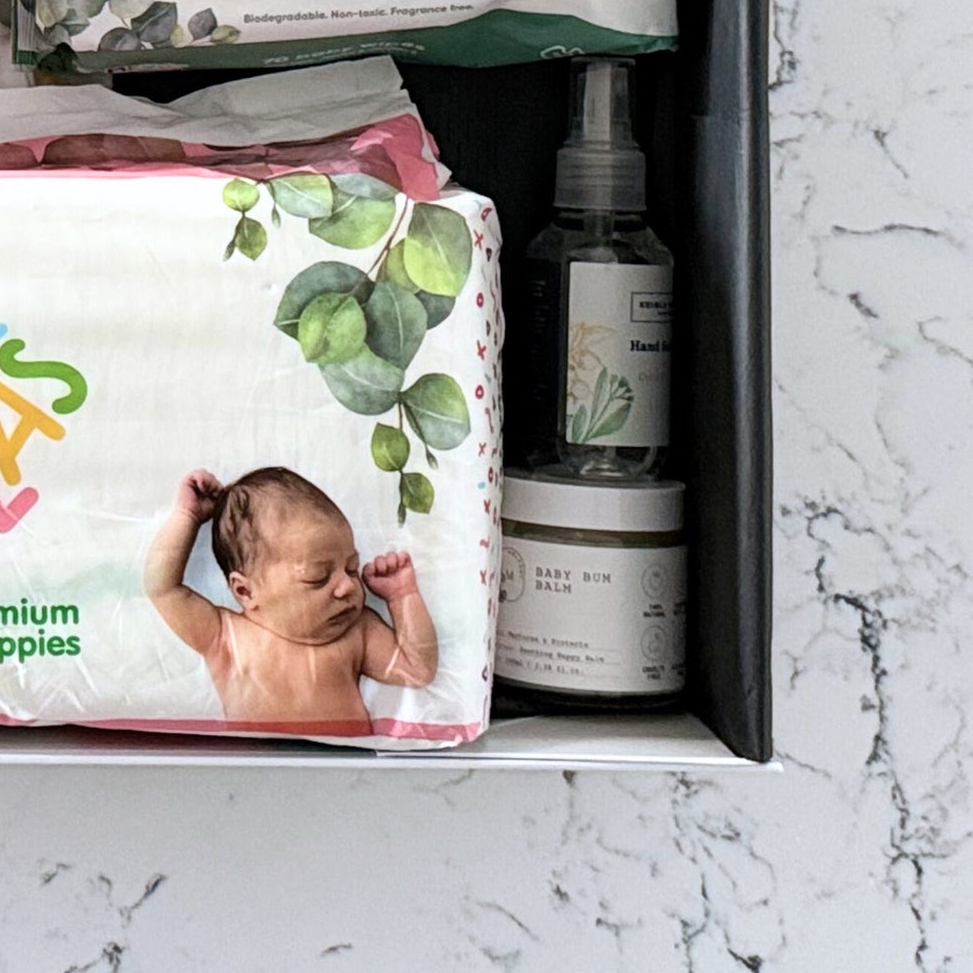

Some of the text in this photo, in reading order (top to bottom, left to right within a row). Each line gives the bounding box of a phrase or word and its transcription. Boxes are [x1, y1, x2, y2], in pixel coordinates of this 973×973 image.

[243, 10, 328, 24] Biodegradable.
[330, 8, 389, 19] Non-toxic.
[390, 5, 448, 16] Fragrance
[630, 339, 660, 352] Hand
[535, 566, 612, 584] BABY BUM
[535, 580, 573, 594] BALM
